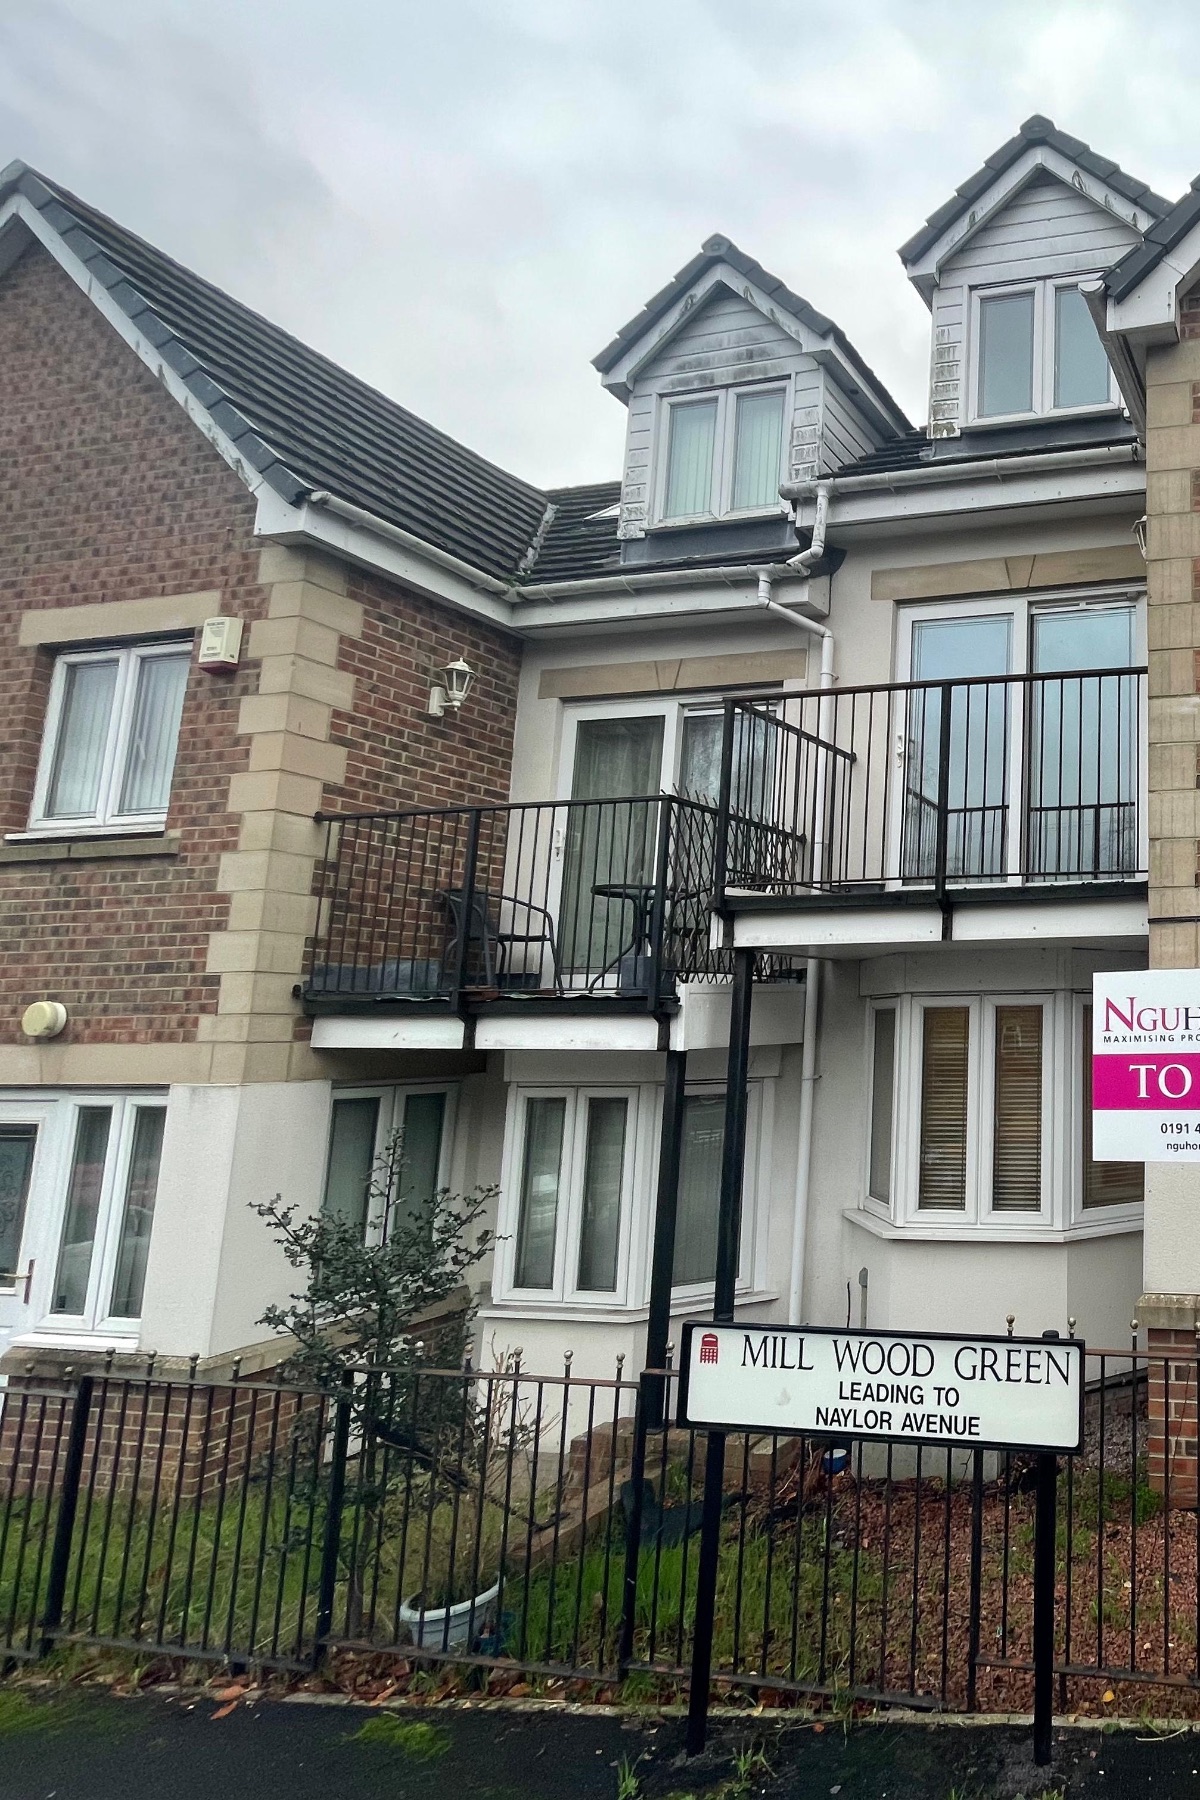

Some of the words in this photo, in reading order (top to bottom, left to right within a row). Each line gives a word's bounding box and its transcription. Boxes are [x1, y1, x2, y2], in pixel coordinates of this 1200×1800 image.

[1103, 1034, 1175, 1044] MAXIMISING
[1129, 1064, 1193, 1099] TO
[1160, 1123, 1190, 1134] 0191
[741, 1334, 814, 1371] MILL
[832, 1339, 935, 1377] WOOD
[954, 1346, 1071, 1386] GREEN
[838, 1381, 924, 1406] LEADING
[932, 1387, 960, 1407] TO
[815, 1407, 893, 1431] NAYLOR
[901, 1414, 981, 1436] AVENUE
